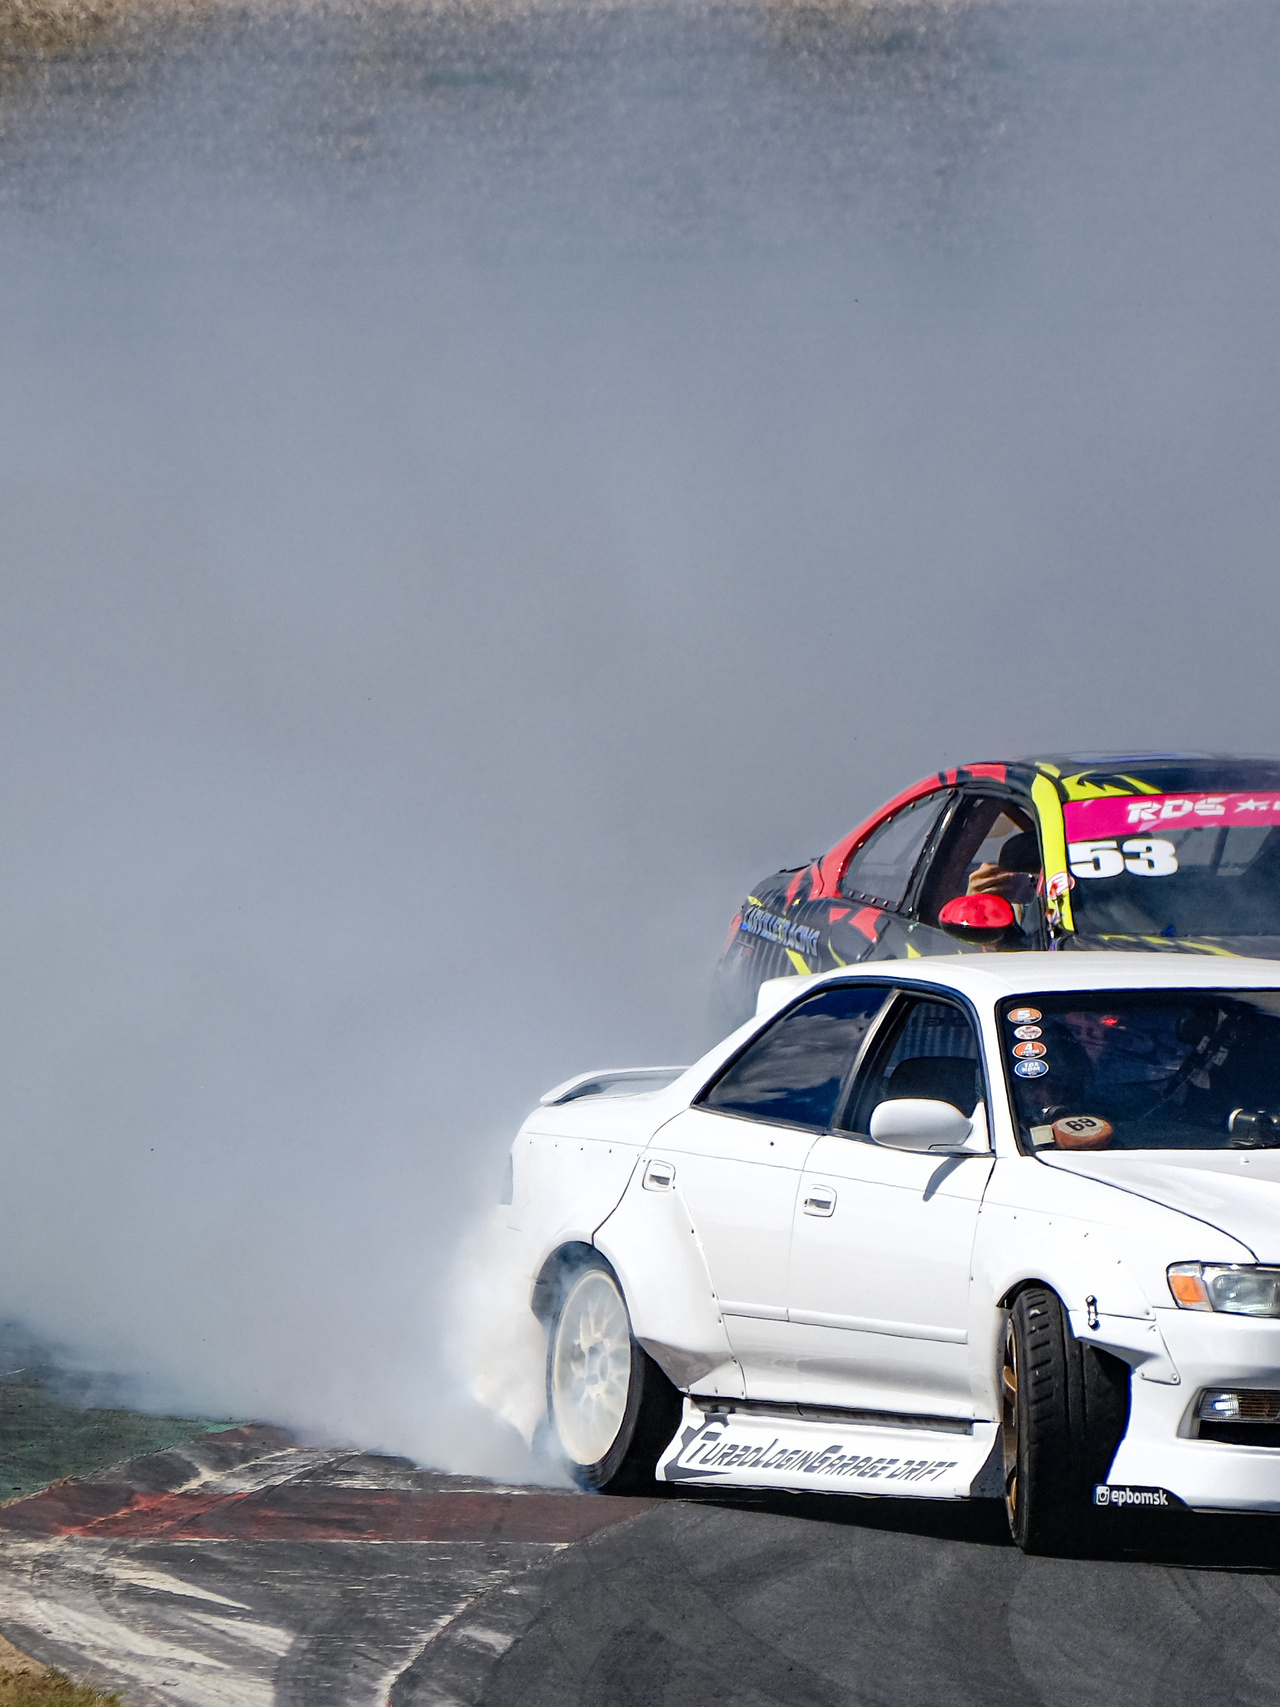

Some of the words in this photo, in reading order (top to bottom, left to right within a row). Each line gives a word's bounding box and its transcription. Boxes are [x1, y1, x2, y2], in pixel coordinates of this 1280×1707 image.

[1127, 797, 1227, 823] RDS
[1067, 839, 1179, 879] 53
[1065, 1118, 1097, 1131] 69
[886, 1459, 959, 1481] DRIFT
[1111, 1487, 1169, 1507] epbomsk
